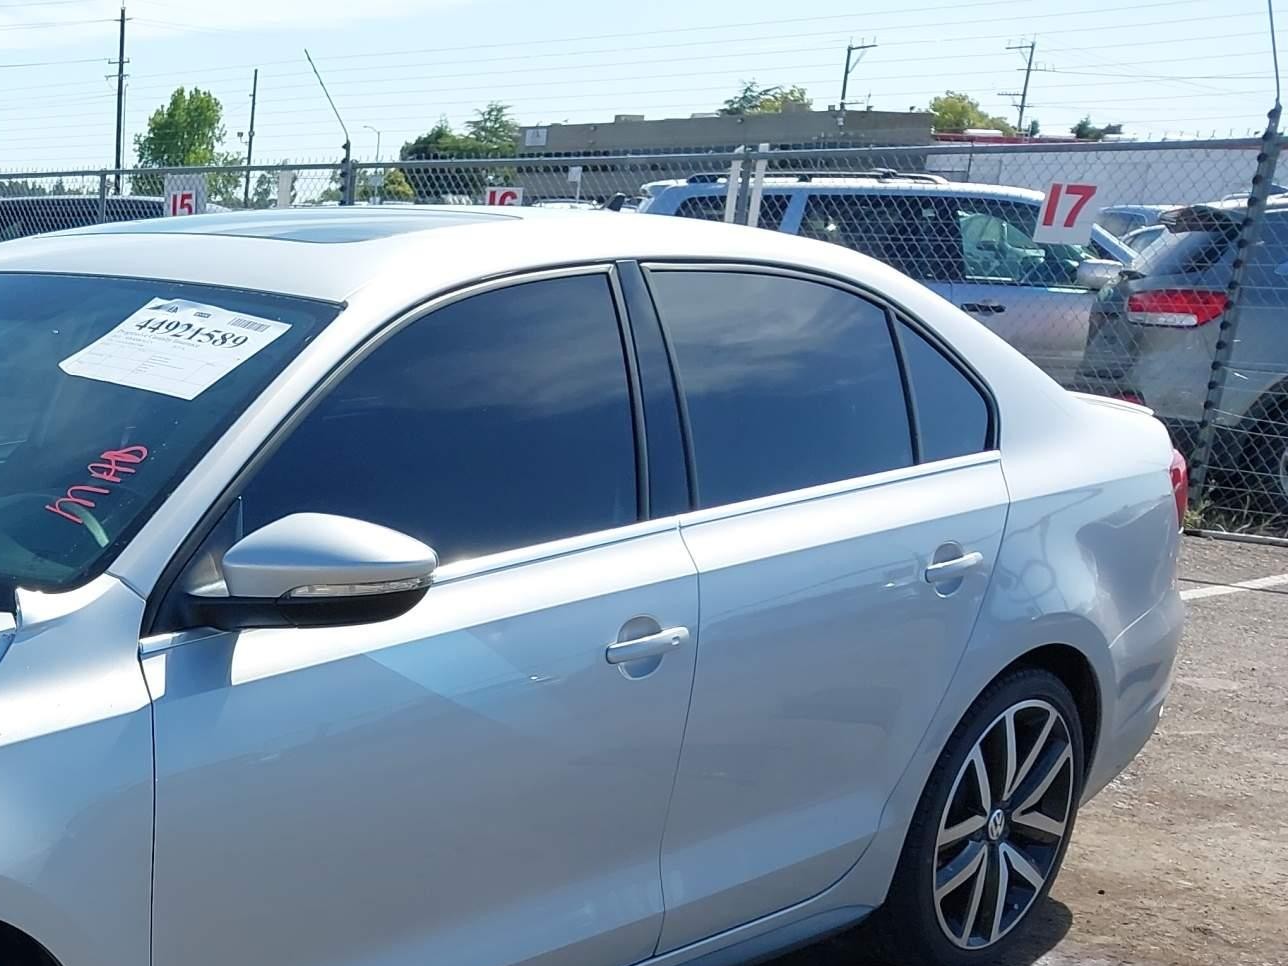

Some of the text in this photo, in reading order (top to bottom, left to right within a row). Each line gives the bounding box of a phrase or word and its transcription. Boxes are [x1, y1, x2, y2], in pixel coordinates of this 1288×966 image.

[172, 193, 193, 217] 15
[1042, 183, 1097, 227] 17
[136, 317, 249, 349] 44921589
